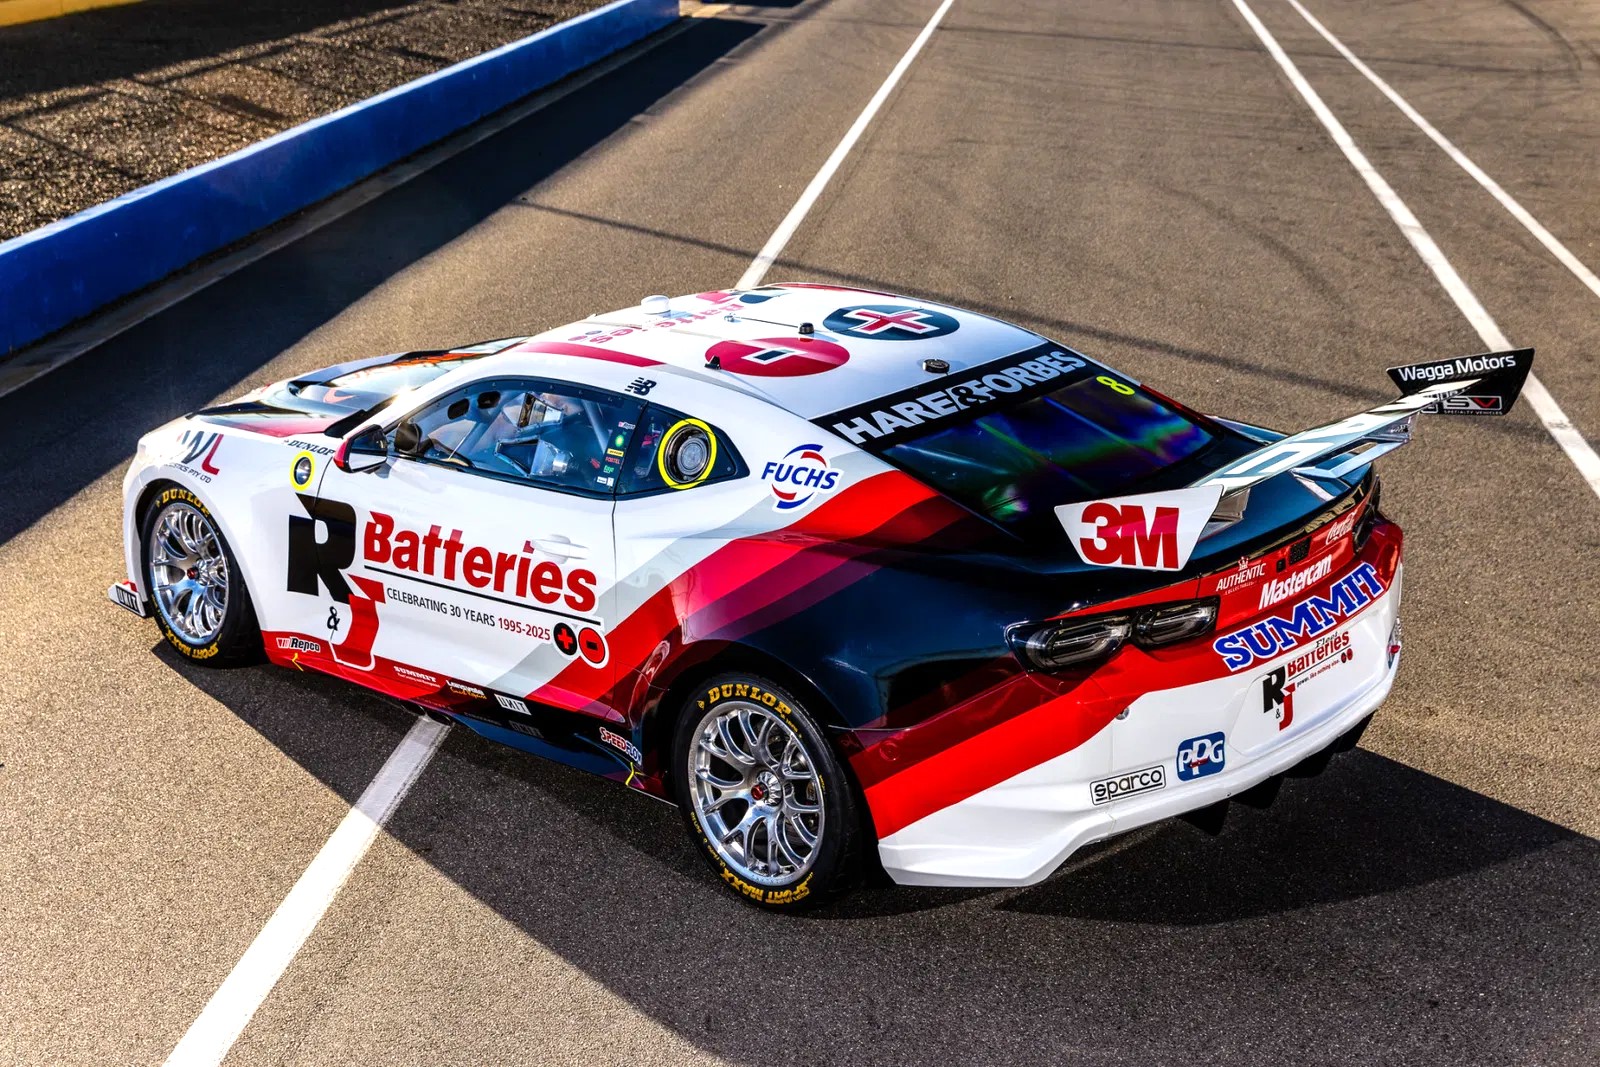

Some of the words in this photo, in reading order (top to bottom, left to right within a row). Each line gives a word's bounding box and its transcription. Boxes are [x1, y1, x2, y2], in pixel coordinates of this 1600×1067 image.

[1398, 364, 1454, 382] Wagga
[1455, 355, 1516, 374] Motors
[1096, 375, 1135, 396] 8
[288, 440, 335, 456] DUNLOP
[188, 468, 201, 477] PTY
[200, 474, 212, 484] LTD
[761, 461, 839, 490] FUCHS
[162, 488, 211, 518] DUNLOP
[1080, 502, 1180, 569] 3M
[287, 492, 356, 604] R
[327, 606, 340, 631] &
[364, 511, 597, 612] Batteries
[1216, 563, 1267, 592] AUTHENTIC
[1259, 554, 1333, 610] Mastercam
[386, 587, 448, 615] CELEBRATING
[449, 605, 462, 618] 30
[462, 608, 496, 627] YEARS
[498, 617, 551, 641] 1995-2025
[1213, 562, 1385, 672] SUMMIT
[291, 638, 320, 653] Repco
[393, 665, 437, 683] SUMMIT
[1263, 666, 1286, 713] R
[498, 694, 529, 714] UNIT
[708, 683, 792, 716] DUNLOP
[1179, 738, 1224, 776] PPG
[1094, 769, 1163, 801] sparco
[720, 868, 764, 901] MAXX
[765, 880, 810, 905] SPORT
